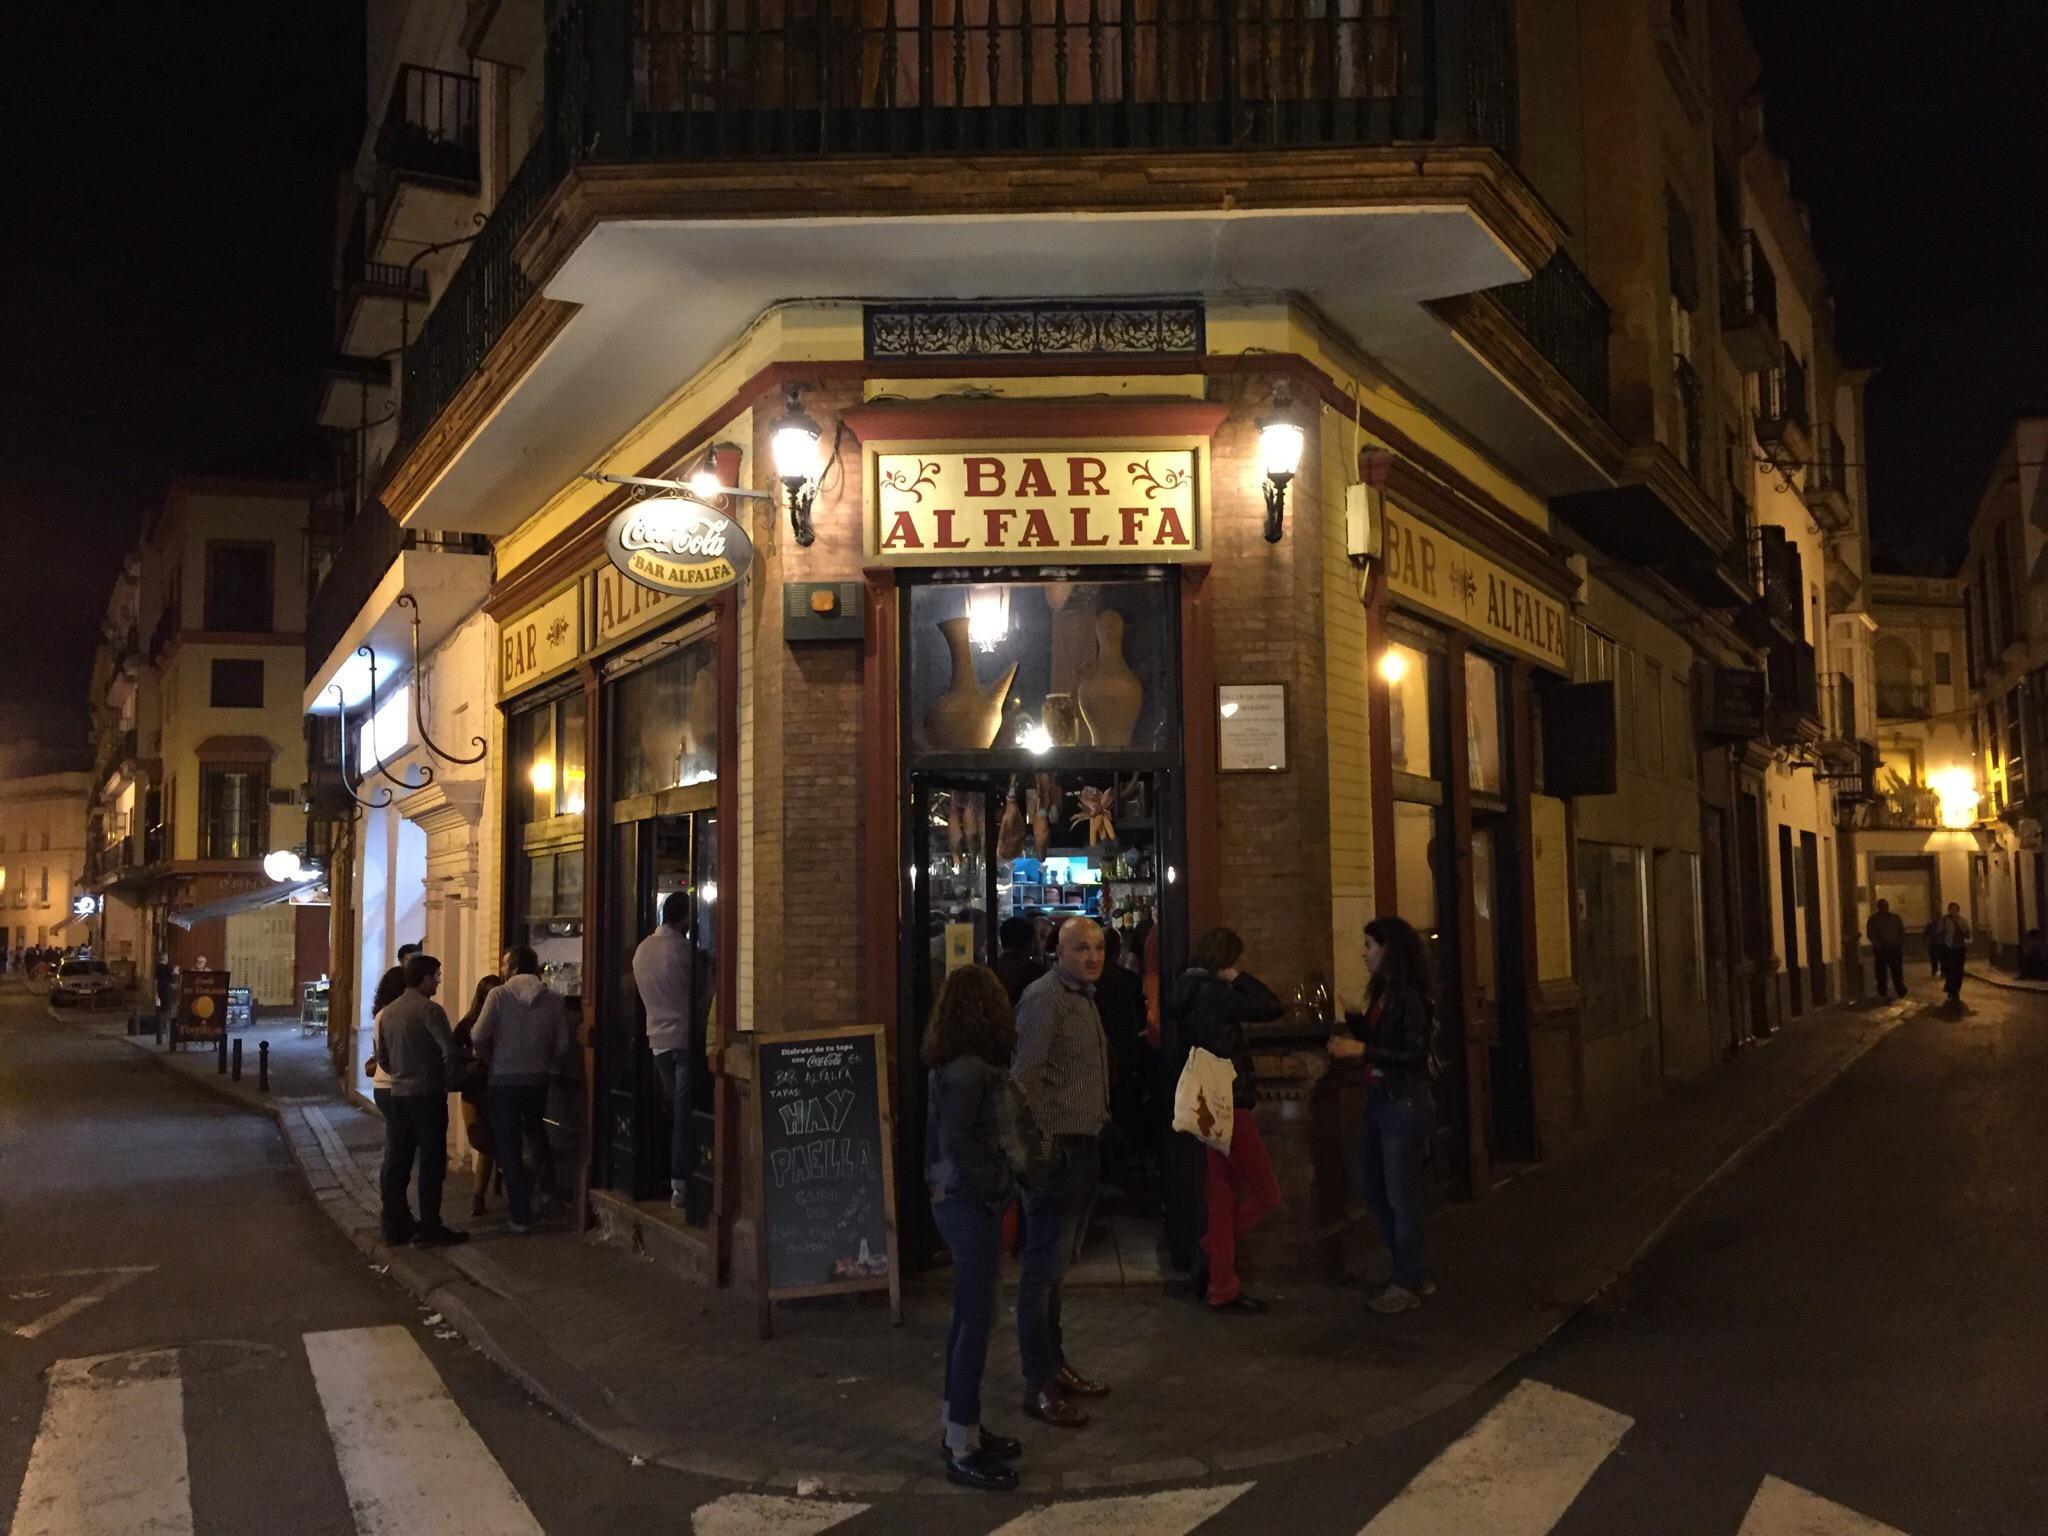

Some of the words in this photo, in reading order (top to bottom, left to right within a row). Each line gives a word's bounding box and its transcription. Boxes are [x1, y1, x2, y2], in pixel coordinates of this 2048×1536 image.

[963, 457, 1110, 497] BAR
[882, 507, 1190, 548] ALFALFA
[635, 555, 665, 579] BAR
[668, 563, 732, 583] ALFALFA
[1385, 517, 1437, 597] BAR
[1488, 573, 1565, 657] ALFALFA
[504, 623, 537, 682] BAR
[770, 1088, 800, 1098] TAPAS
[774, 1068, 798, 1086] BAR
[778, 1088, 856, 1135] HAY
[770, 1138, 876, 1188] PAELLA
